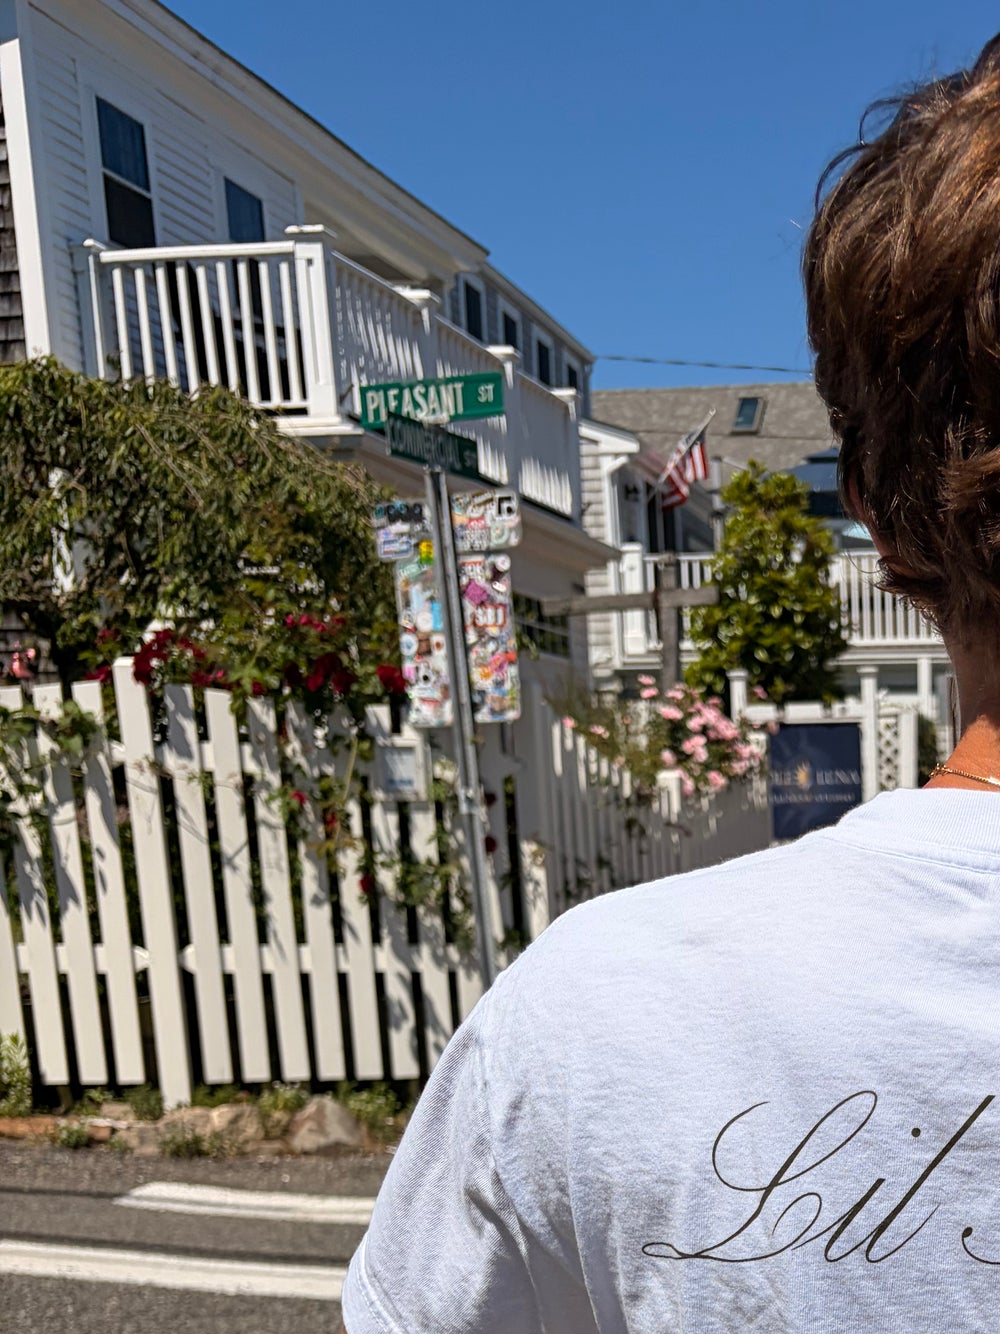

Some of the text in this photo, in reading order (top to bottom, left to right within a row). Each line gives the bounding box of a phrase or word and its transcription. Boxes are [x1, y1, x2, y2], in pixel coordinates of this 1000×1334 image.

[365, 381, 495, 423] PLEASANT ST
[641, 1090, 996, 1264] Lil
